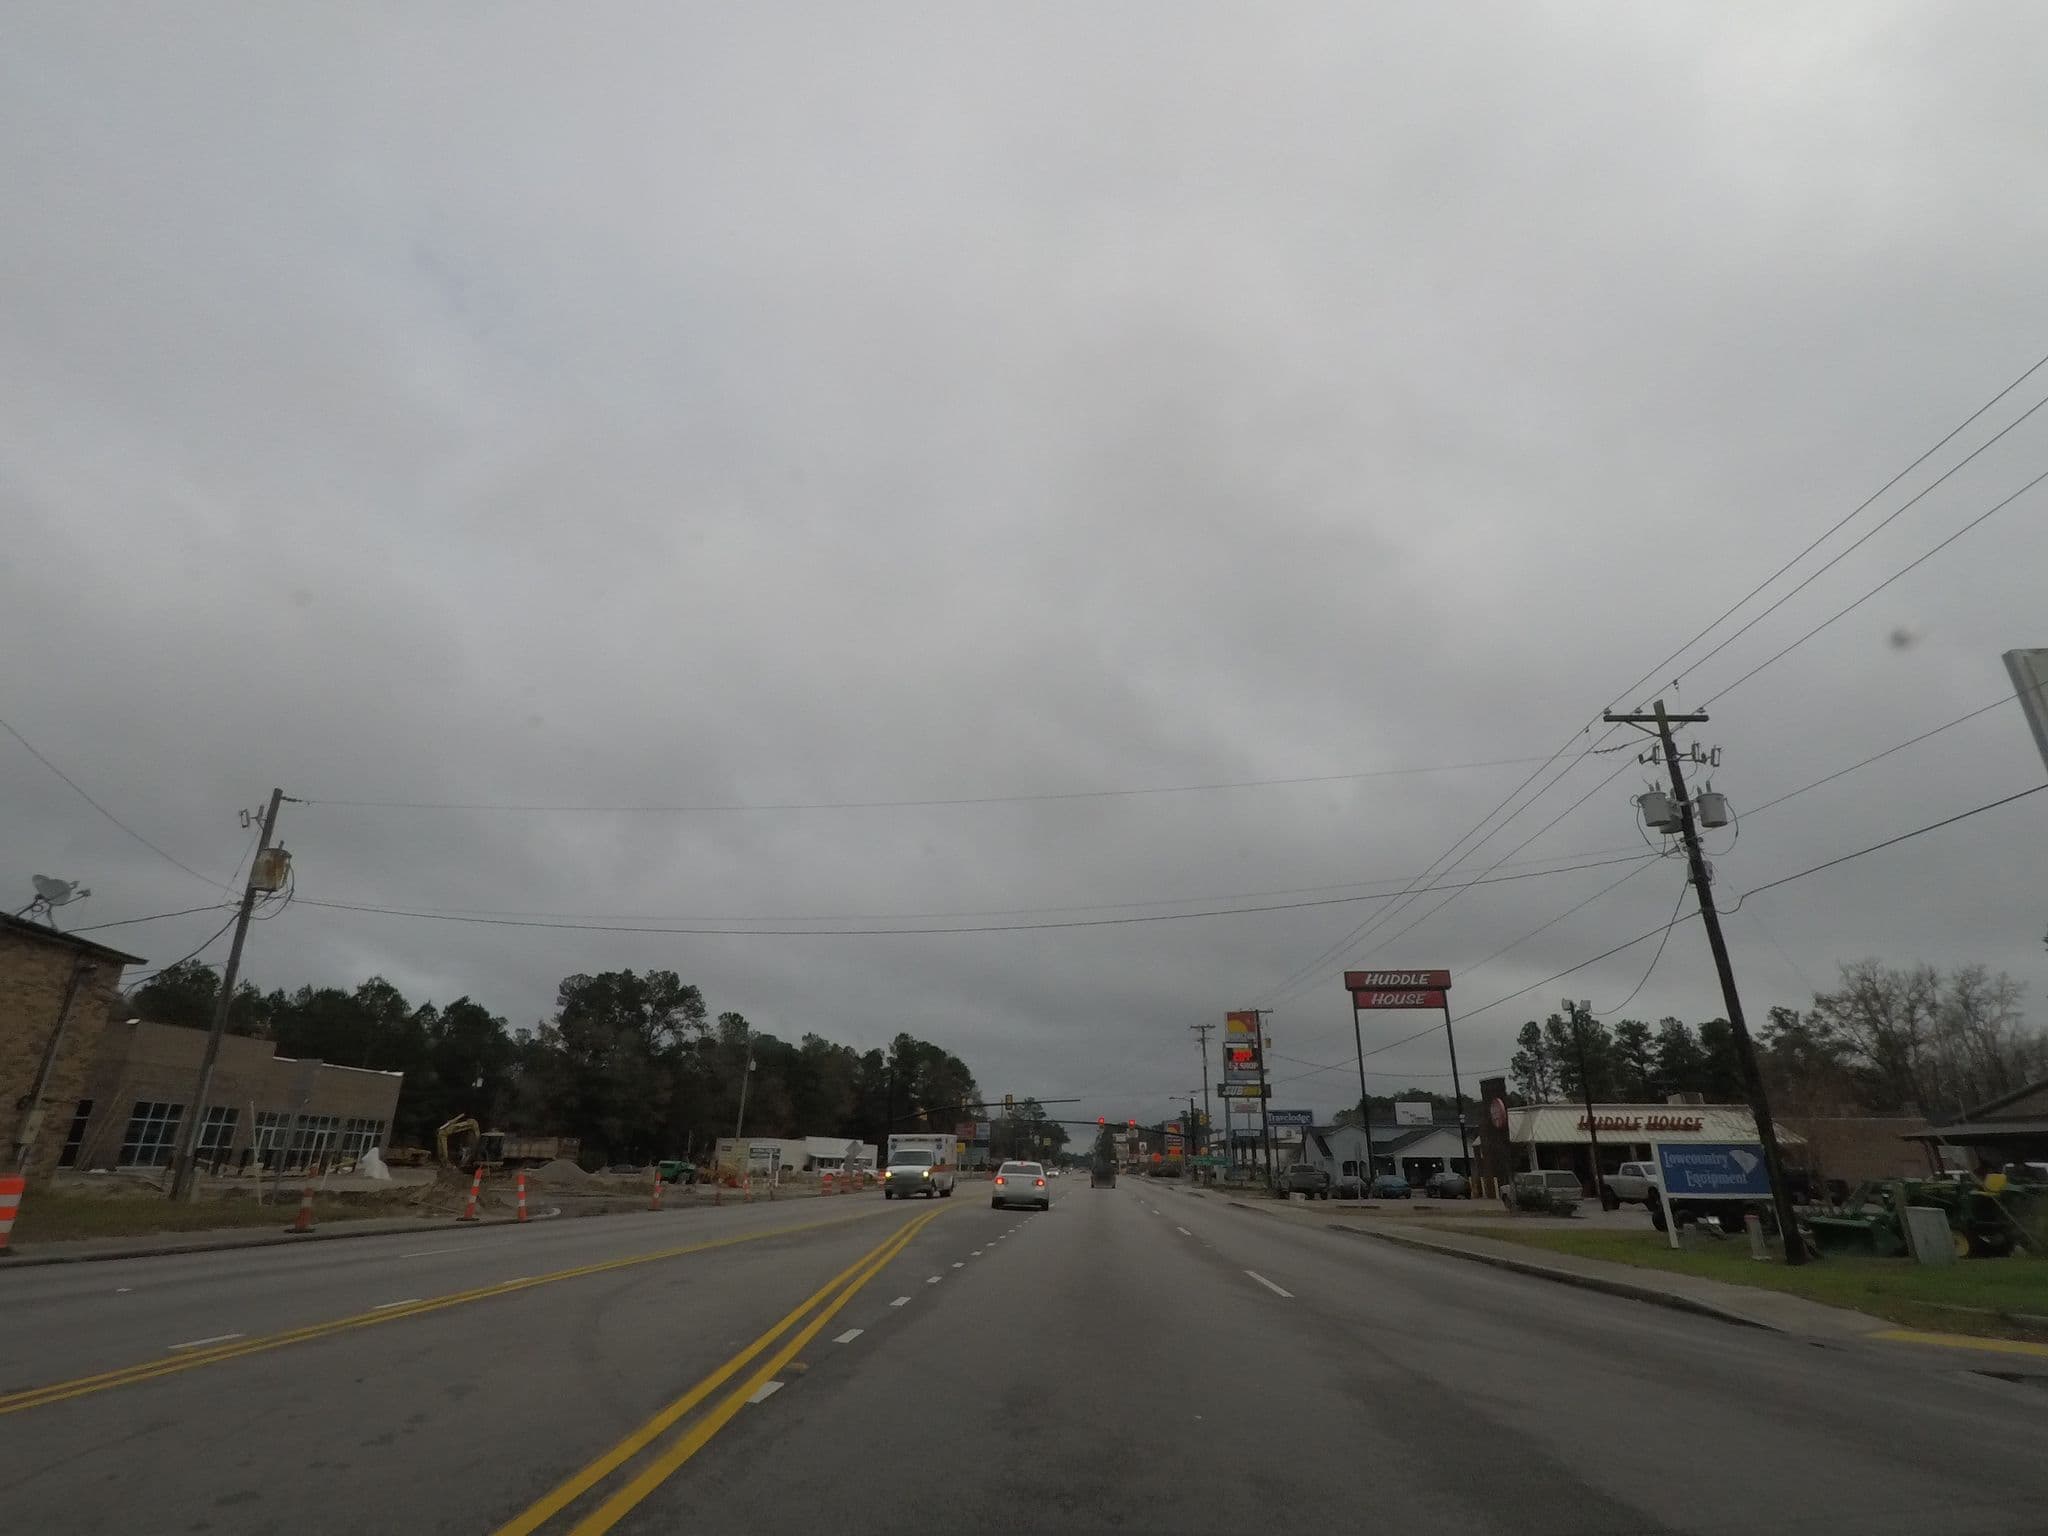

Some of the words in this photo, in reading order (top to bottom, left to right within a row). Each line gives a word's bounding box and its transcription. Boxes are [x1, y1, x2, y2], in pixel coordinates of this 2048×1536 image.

[1365, 973, 1431, 985] HUDDLE
[1371, 993, 1427, 1005] HOUSE
[1268, 1113, 1311, 1125] Travelodge
[1577, 1115, 1643, 1131] HUDDLE
[1645, 1115, 1704, 1131] HOUSE
[1663, 1151, 1728, 1169] Lowcountry
[1685, 1169, 1748, 1188] Equipment
